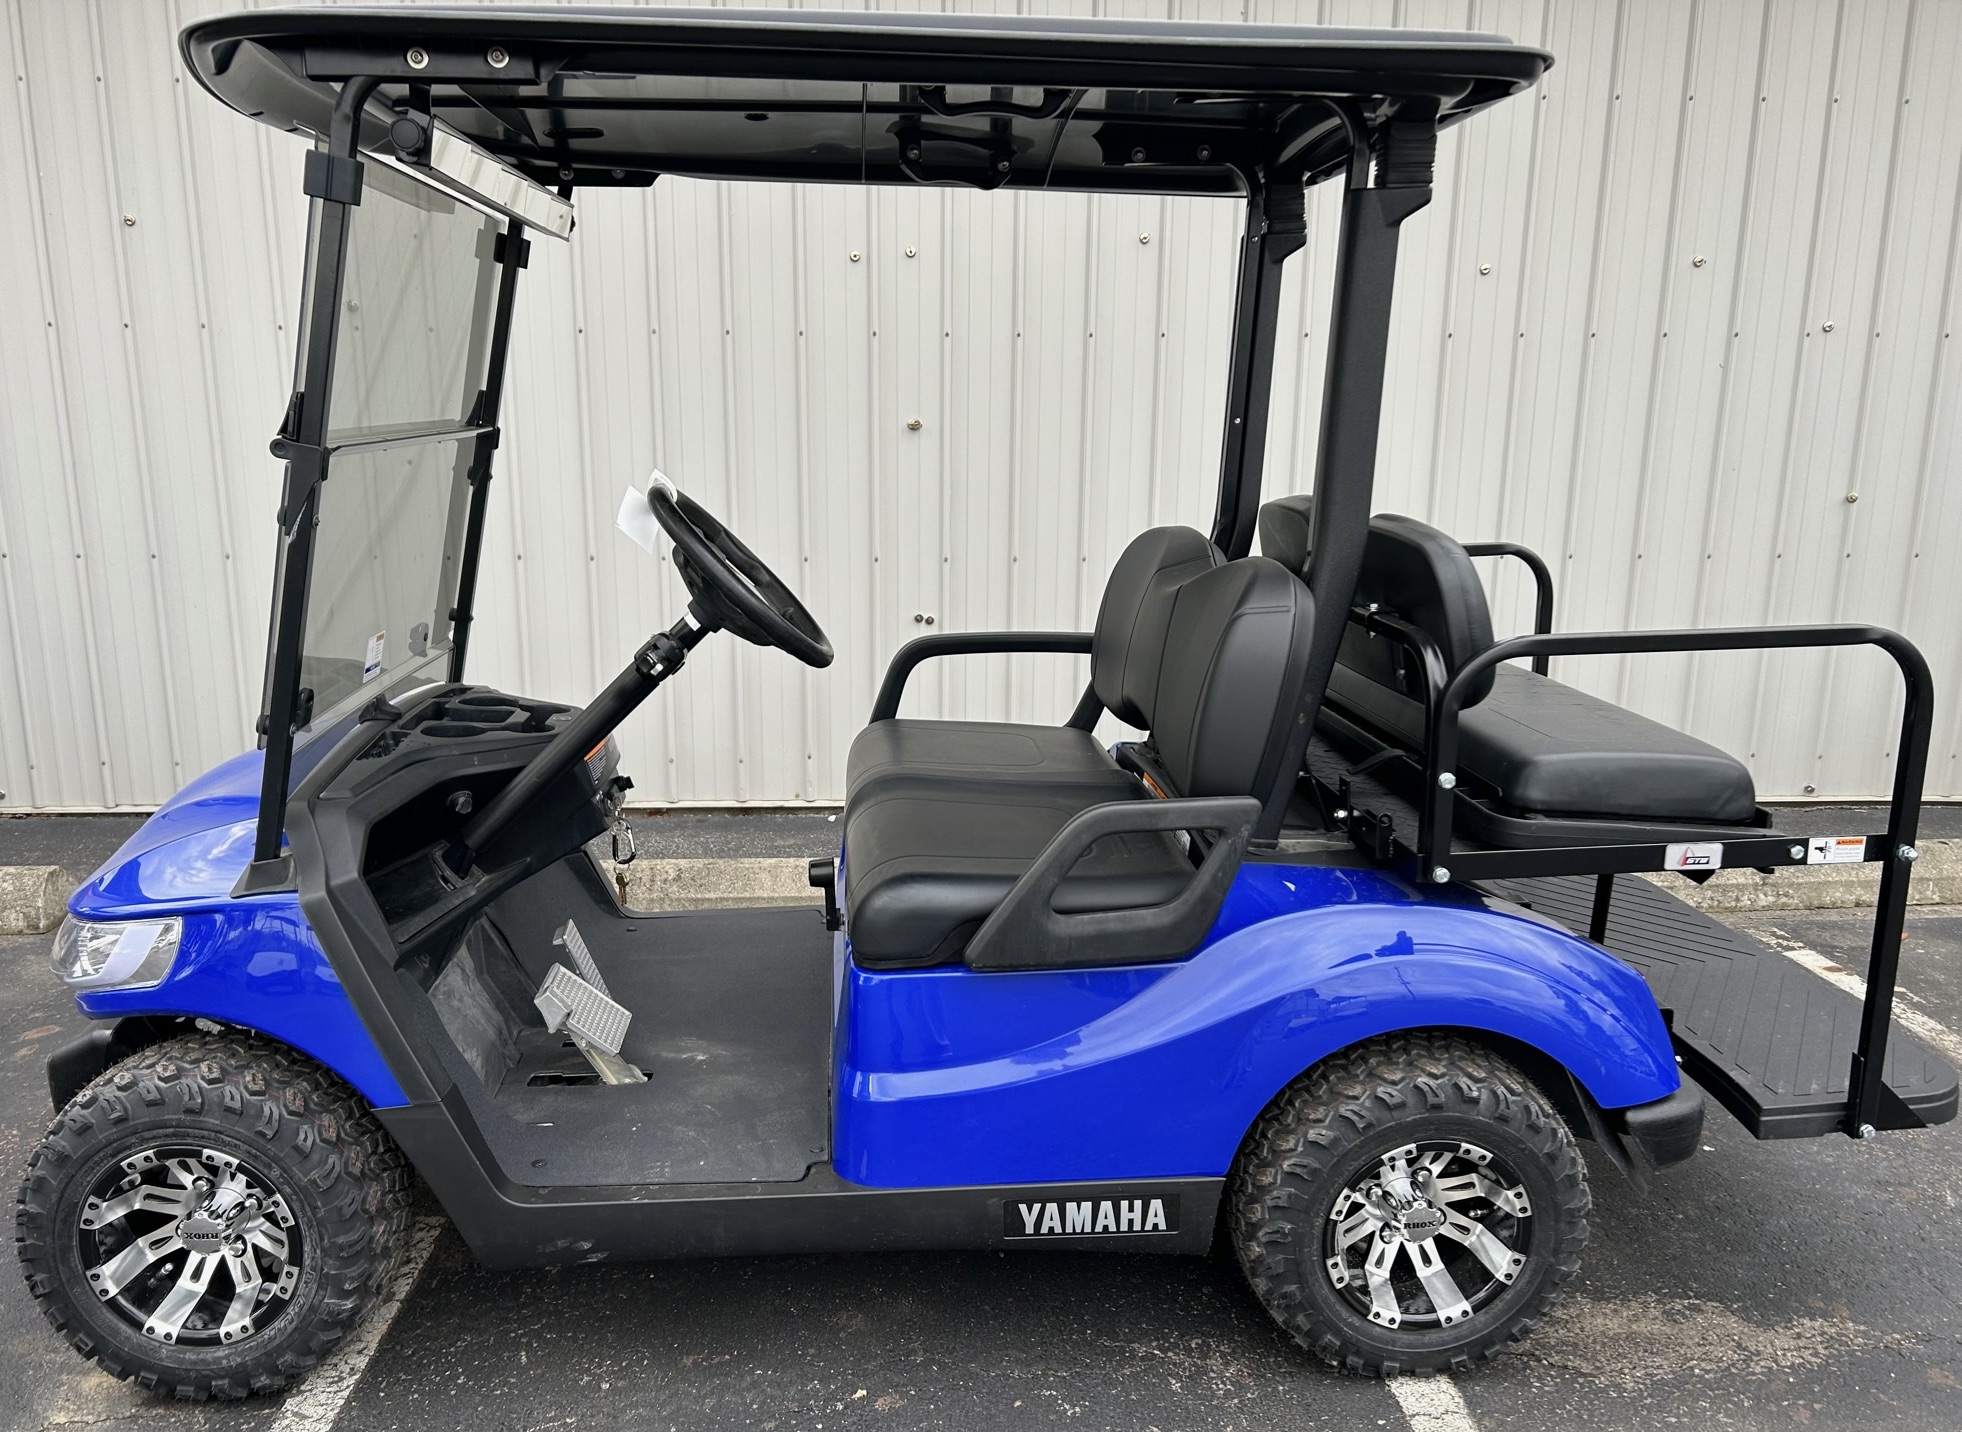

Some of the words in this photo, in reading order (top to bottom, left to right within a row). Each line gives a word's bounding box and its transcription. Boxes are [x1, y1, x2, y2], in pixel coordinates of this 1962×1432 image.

[1018, 1199, 1167, 1234] YAMAHA
[1403, 1220, 1437, 1229] RHOX
[183, 1232, 219, 1240] RHOX
